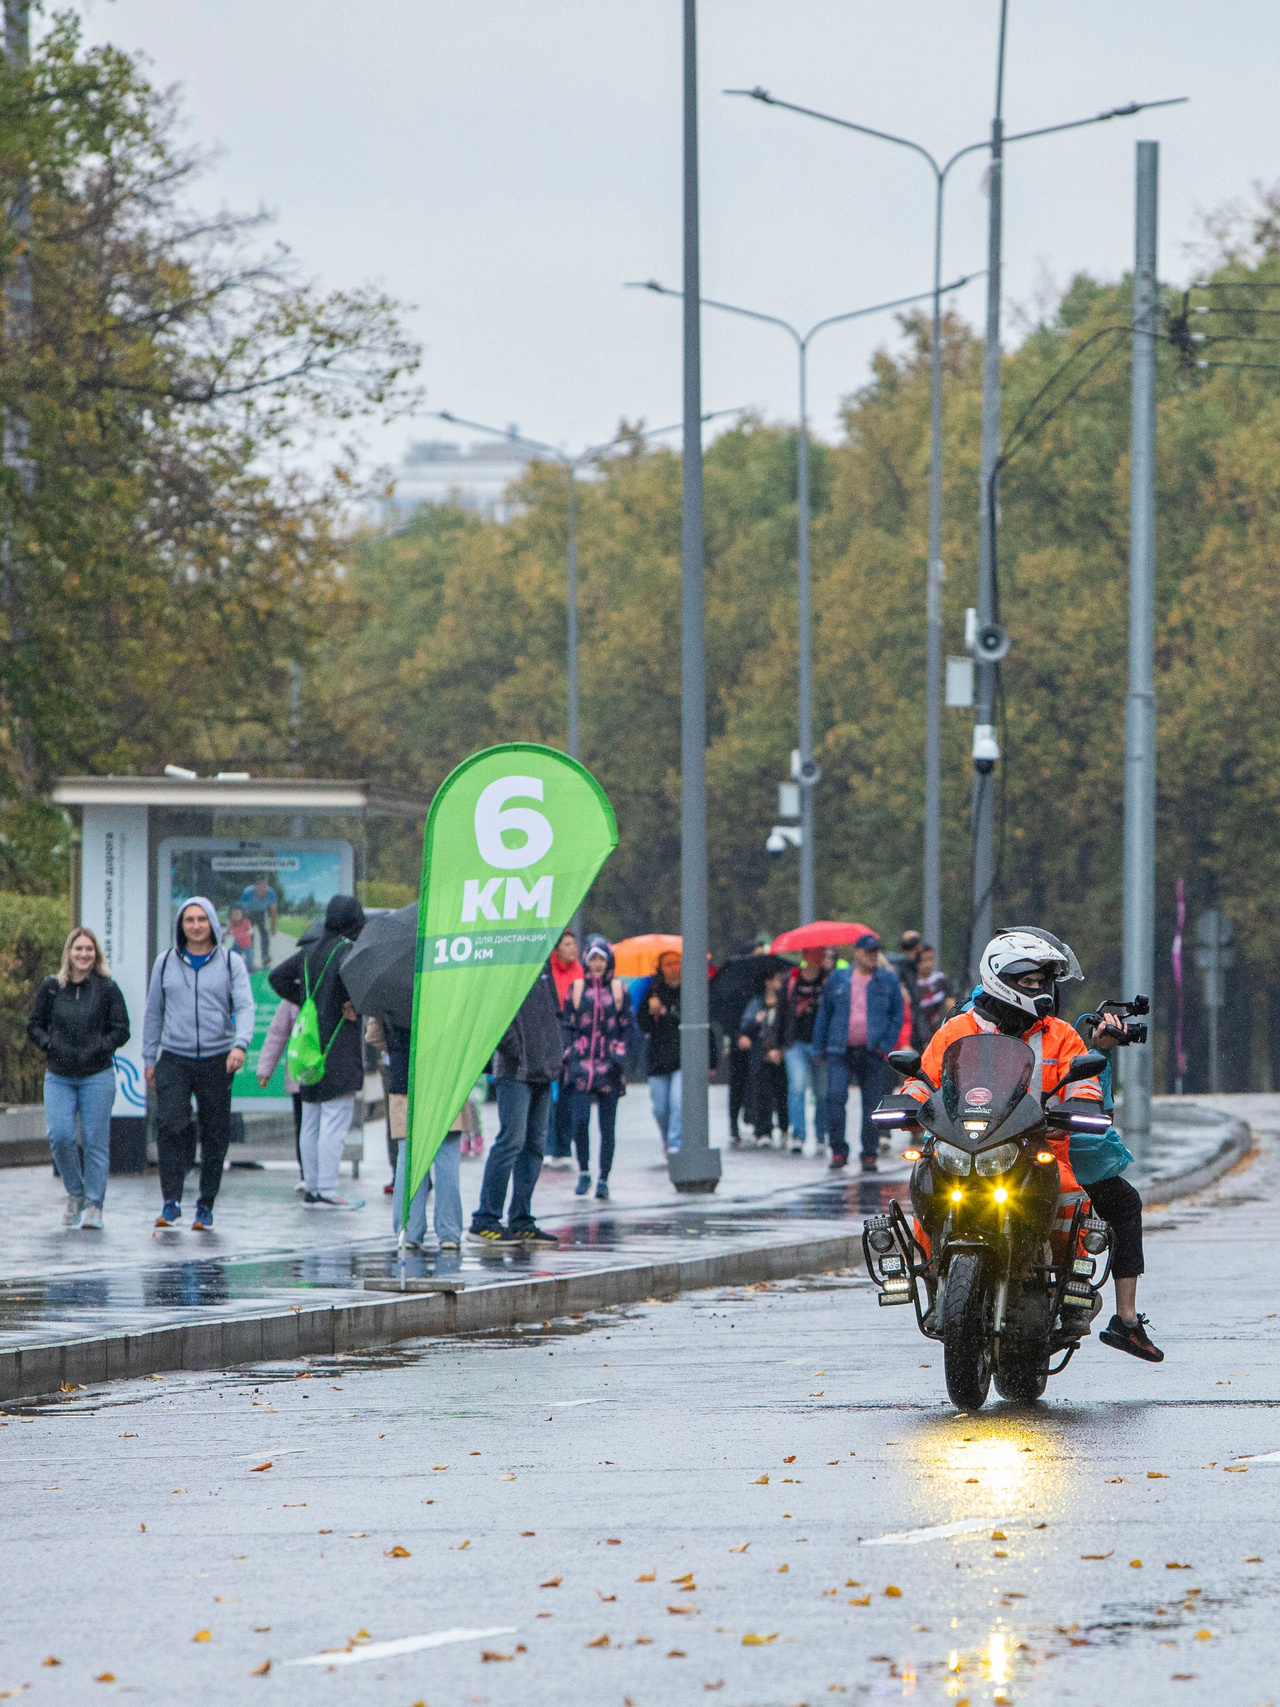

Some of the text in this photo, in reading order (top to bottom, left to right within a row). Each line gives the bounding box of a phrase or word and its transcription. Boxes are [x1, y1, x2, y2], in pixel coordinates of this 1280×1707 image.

[474, 775, 554, 869] 6
[105, 831, 114, 876] дорога
[434, 936, 472, 964] 10
[475, 934, 546, 945] ДЛЯ ДИСТАНЦИИ
